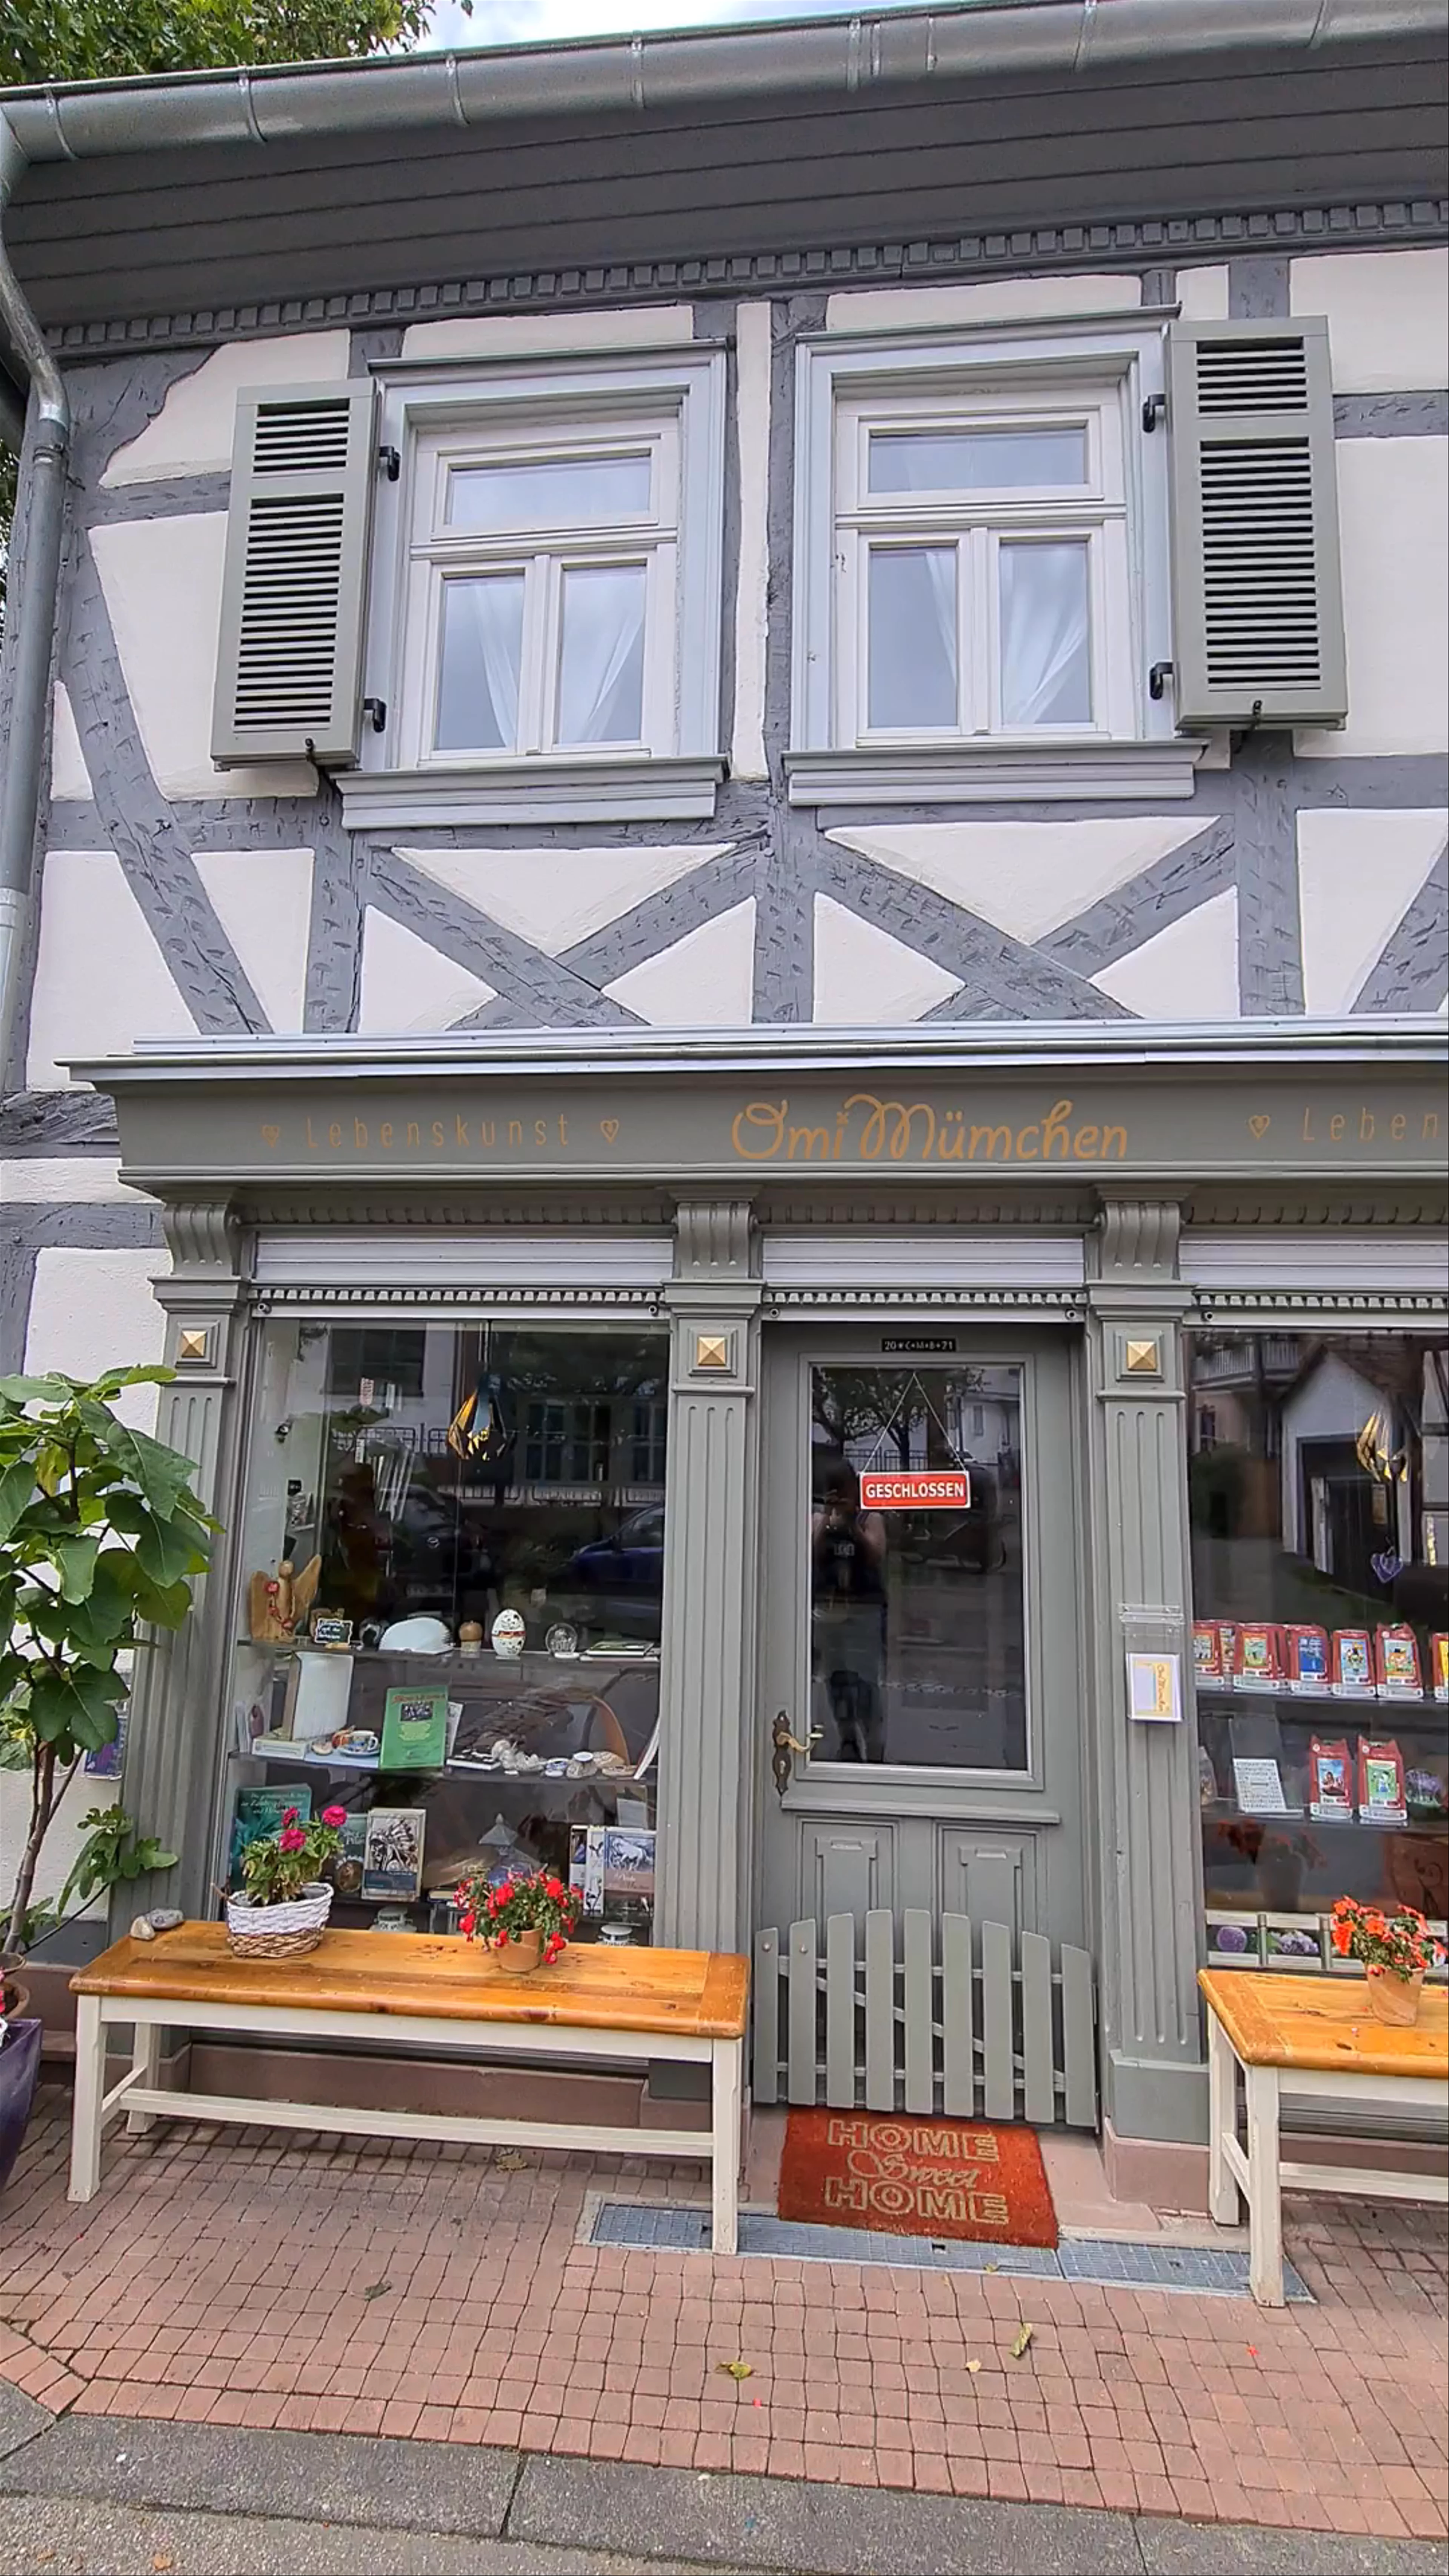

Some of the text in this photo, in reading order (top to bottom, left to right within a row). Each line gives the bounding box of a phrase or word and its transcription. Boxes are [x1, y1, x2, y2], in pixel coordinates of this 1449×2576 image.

[306, 1113, 569, 1148] Lebenskunst
[732, 1094, 1128, 1159] Omi Mümchen
[1303, 1106, 1438, 1141] Leben
[866, 1482, 964, 1498] GESCHLOSSEN
[827, 2119, 999, 2162] HOME
[847, 2150, 982, 2188] Sweet
[824, 2177, 1009, 2225] HOME
